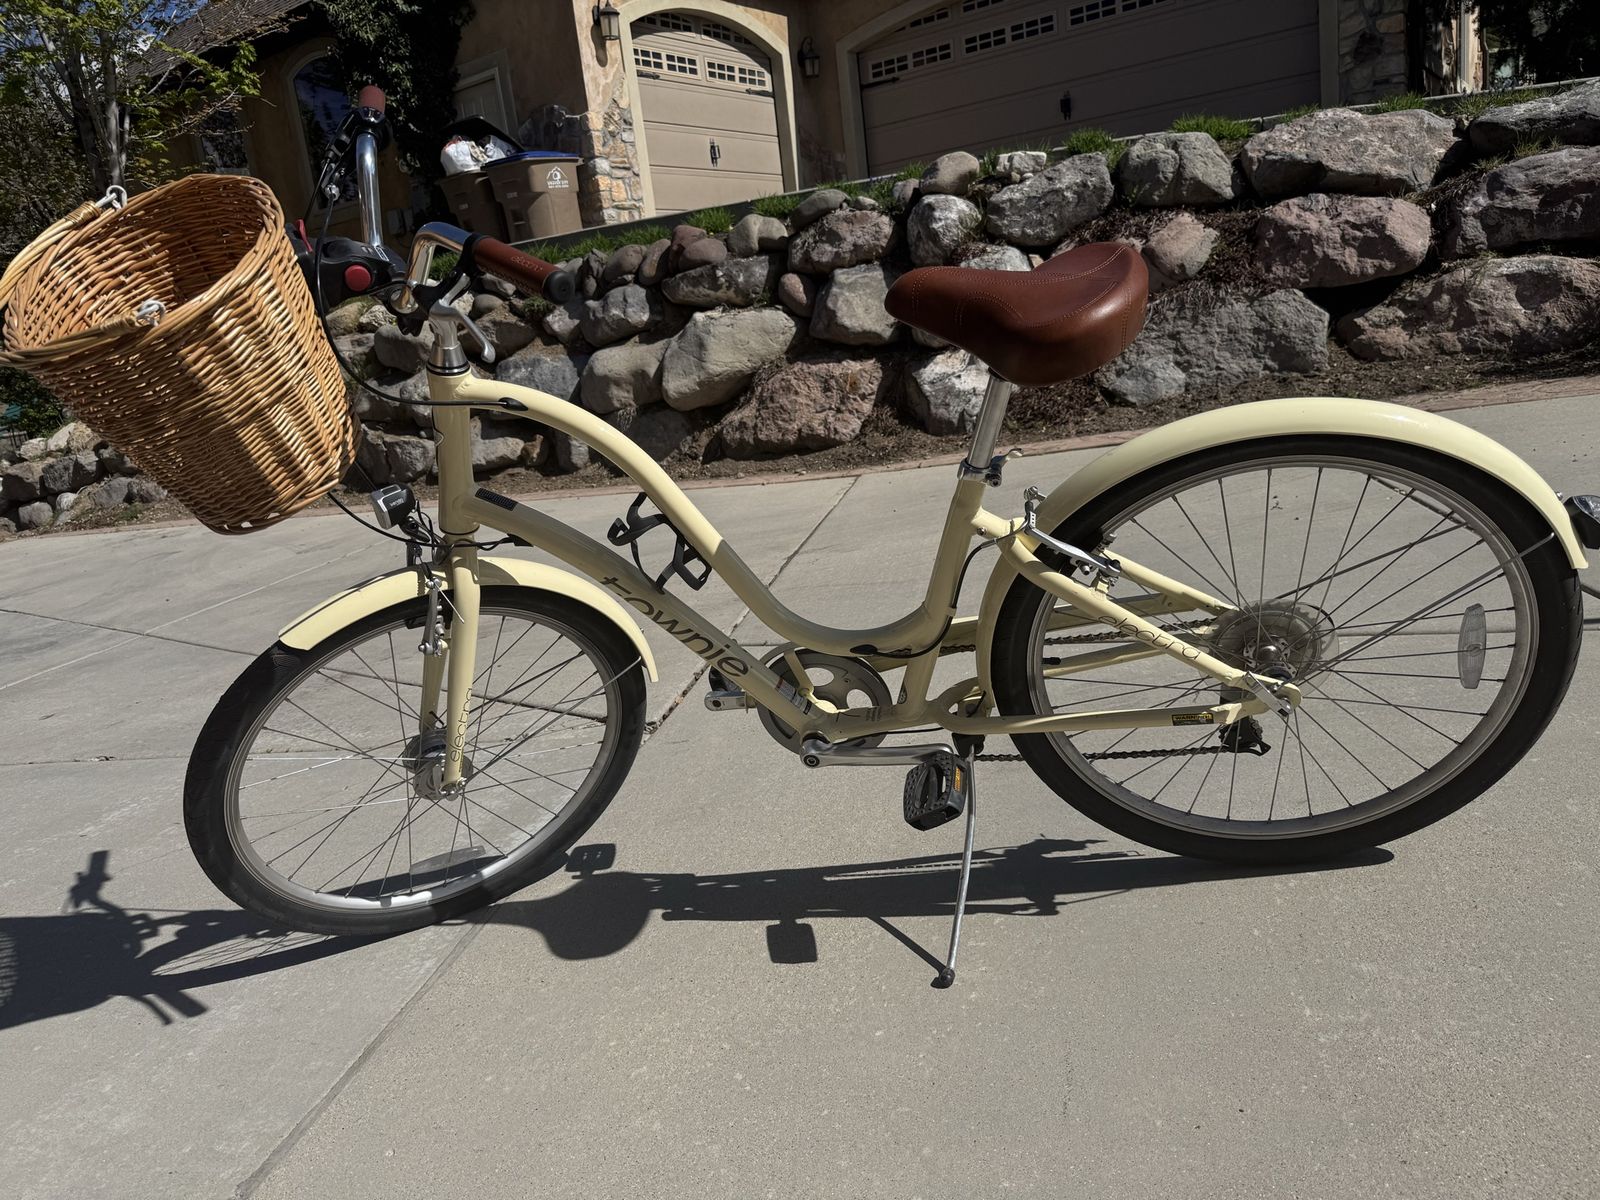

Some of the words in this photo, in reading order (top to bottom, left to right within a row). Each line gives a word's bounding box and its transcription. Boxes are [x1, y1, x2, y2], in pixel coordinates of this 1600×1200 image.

[600, 576, 749, 677] townie
[1098, 615, 1201, 660] electra
[449, 687, 472, 762] electra
